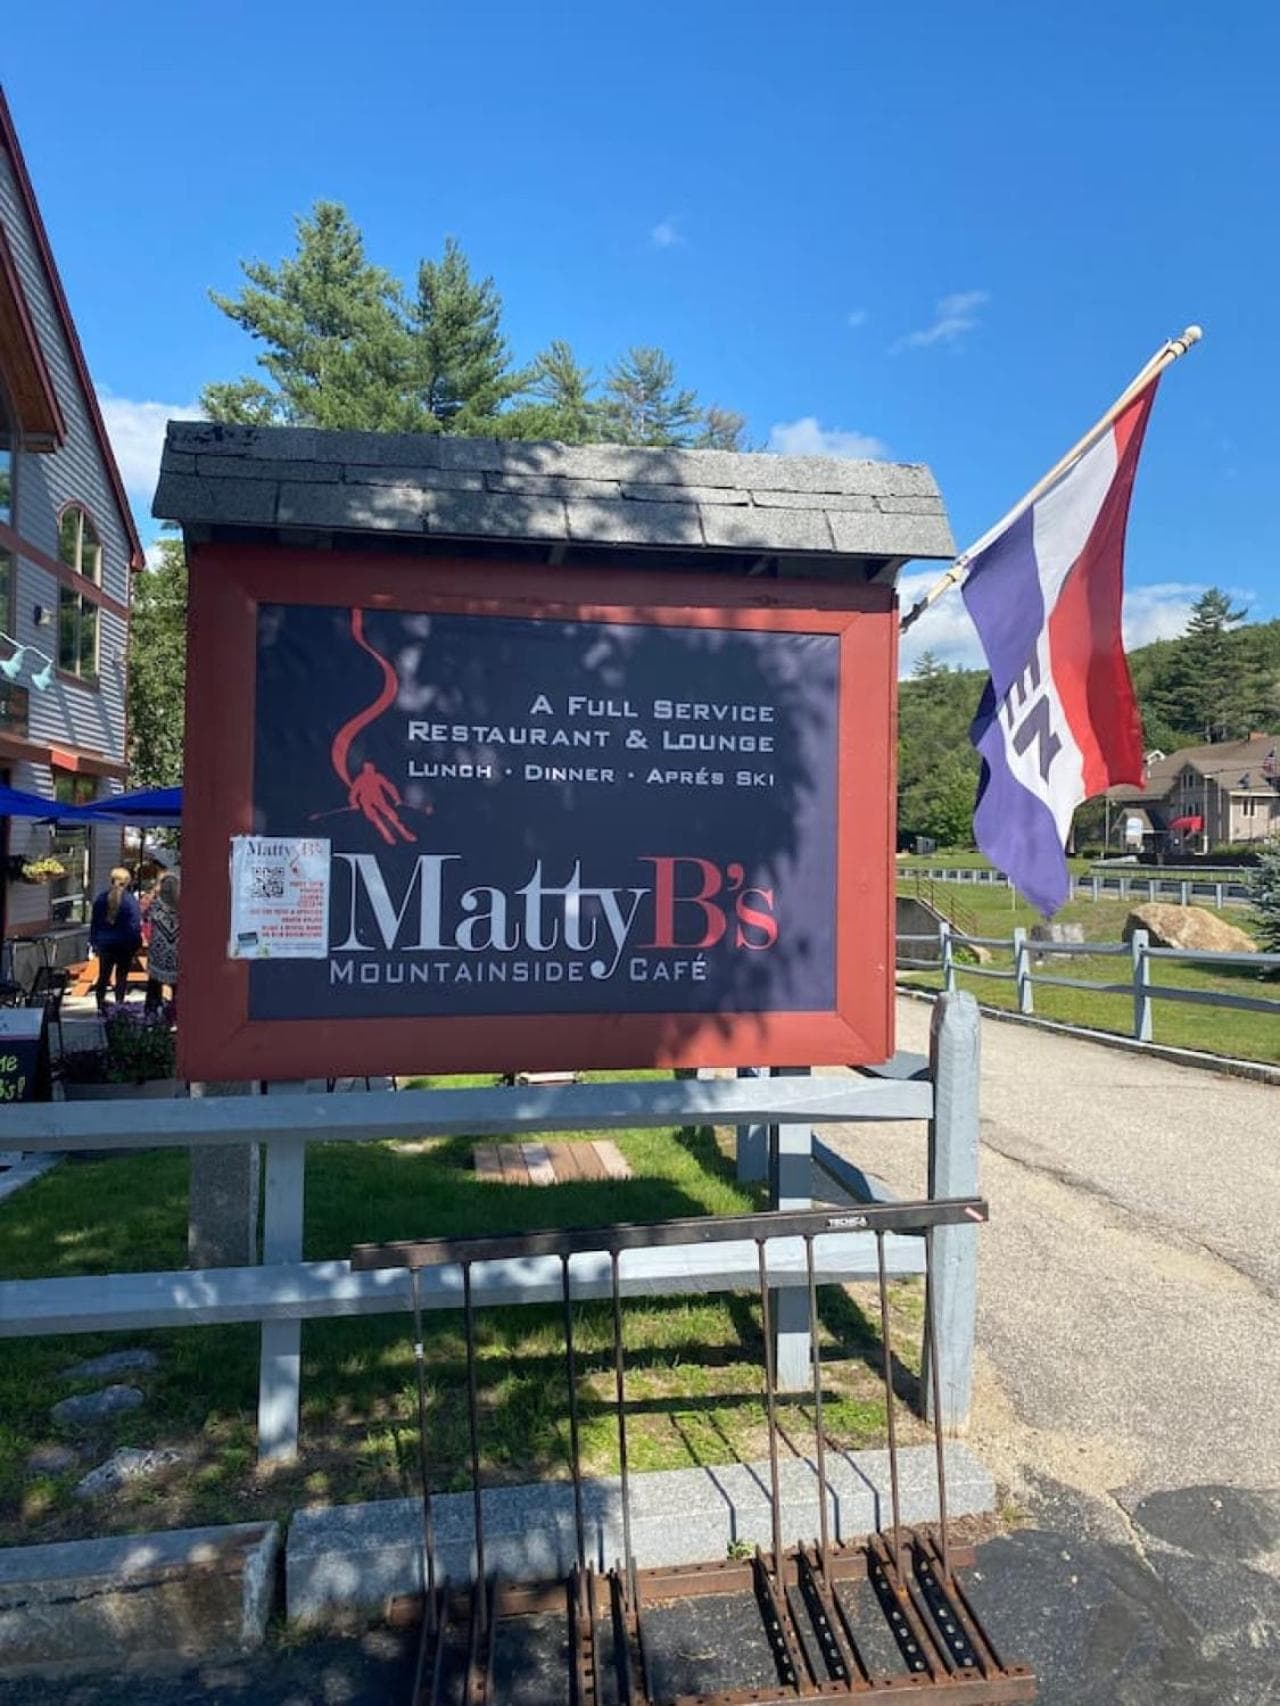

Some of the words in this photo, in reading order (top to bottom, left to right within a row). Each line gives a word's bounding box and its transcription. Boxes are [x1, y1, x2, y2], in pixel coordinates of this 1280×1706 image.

[529, 694, 554, 715] A
[568, 695, 639, 718] FULL
[653, 699, 775, 723] SERVICE
[408, 720, 611, 748] RESTAURANT
[625, 729, 649, 749] &
[663, 730, 775, 753] LOUNGE
[408, 760, 493, 779] LUNCH
[524, 764, 615, 783] DINNER
[736, 770, 775, 787] SKI
[329, 959, 584, 984] MOUNTAINSIDE
[629, 952, 707, 982] CAFÉ
